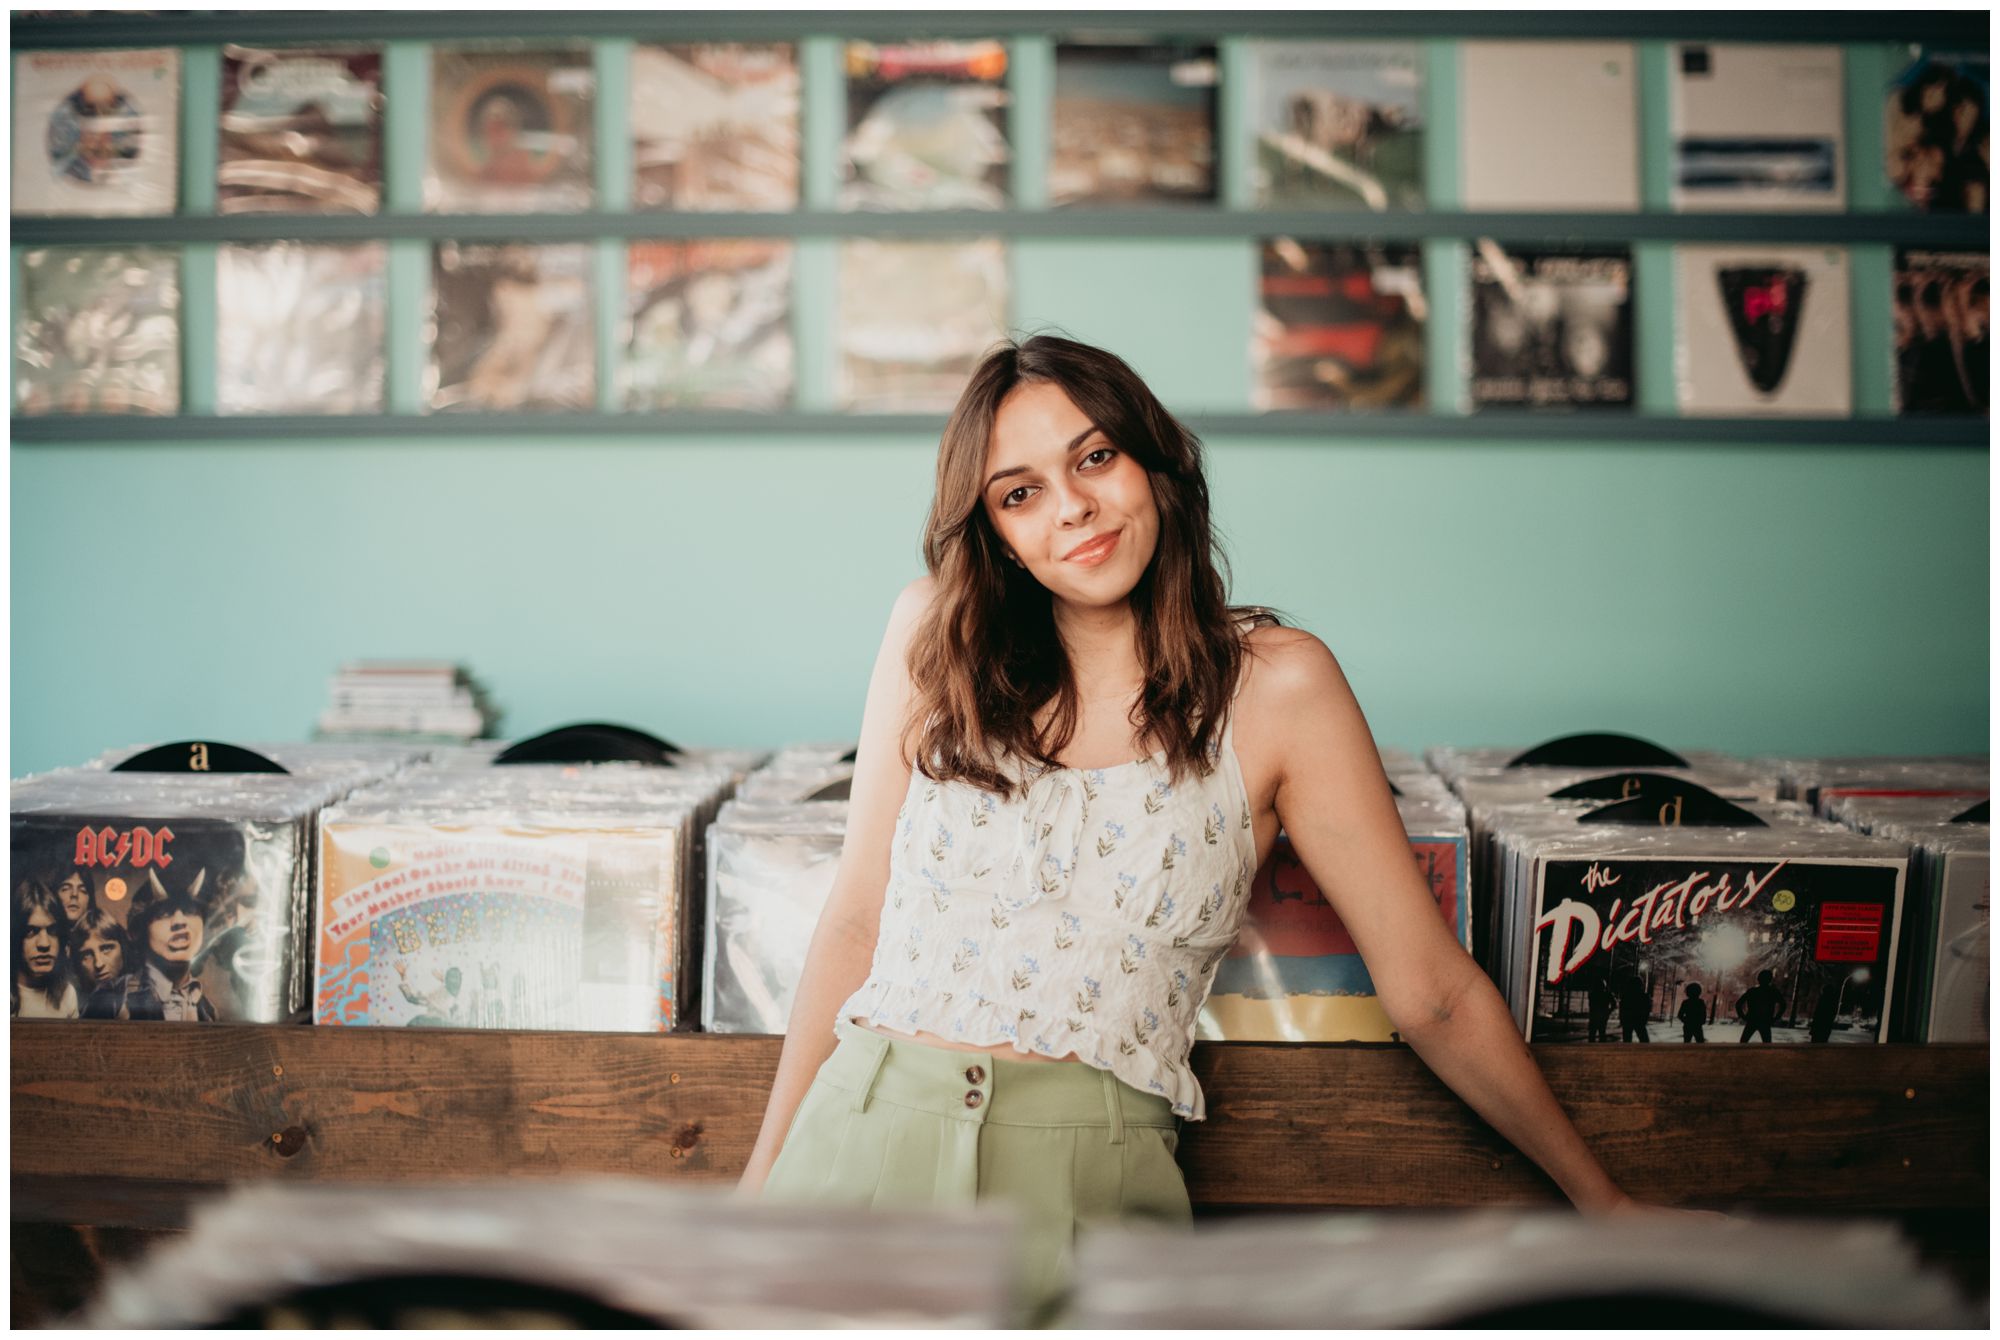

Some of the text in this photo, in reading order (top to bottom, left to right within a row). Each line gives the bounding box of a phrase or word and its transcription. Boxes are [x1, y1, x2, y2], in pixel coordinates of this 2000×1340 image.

[189, 743, 210, 771] a
[1658, 795, 1683, 829] d
[74, 825, 175, 869] AC/DC
[1581, 861, 1621, 893] the
[1536, 859, 1791, 984] Dictators
